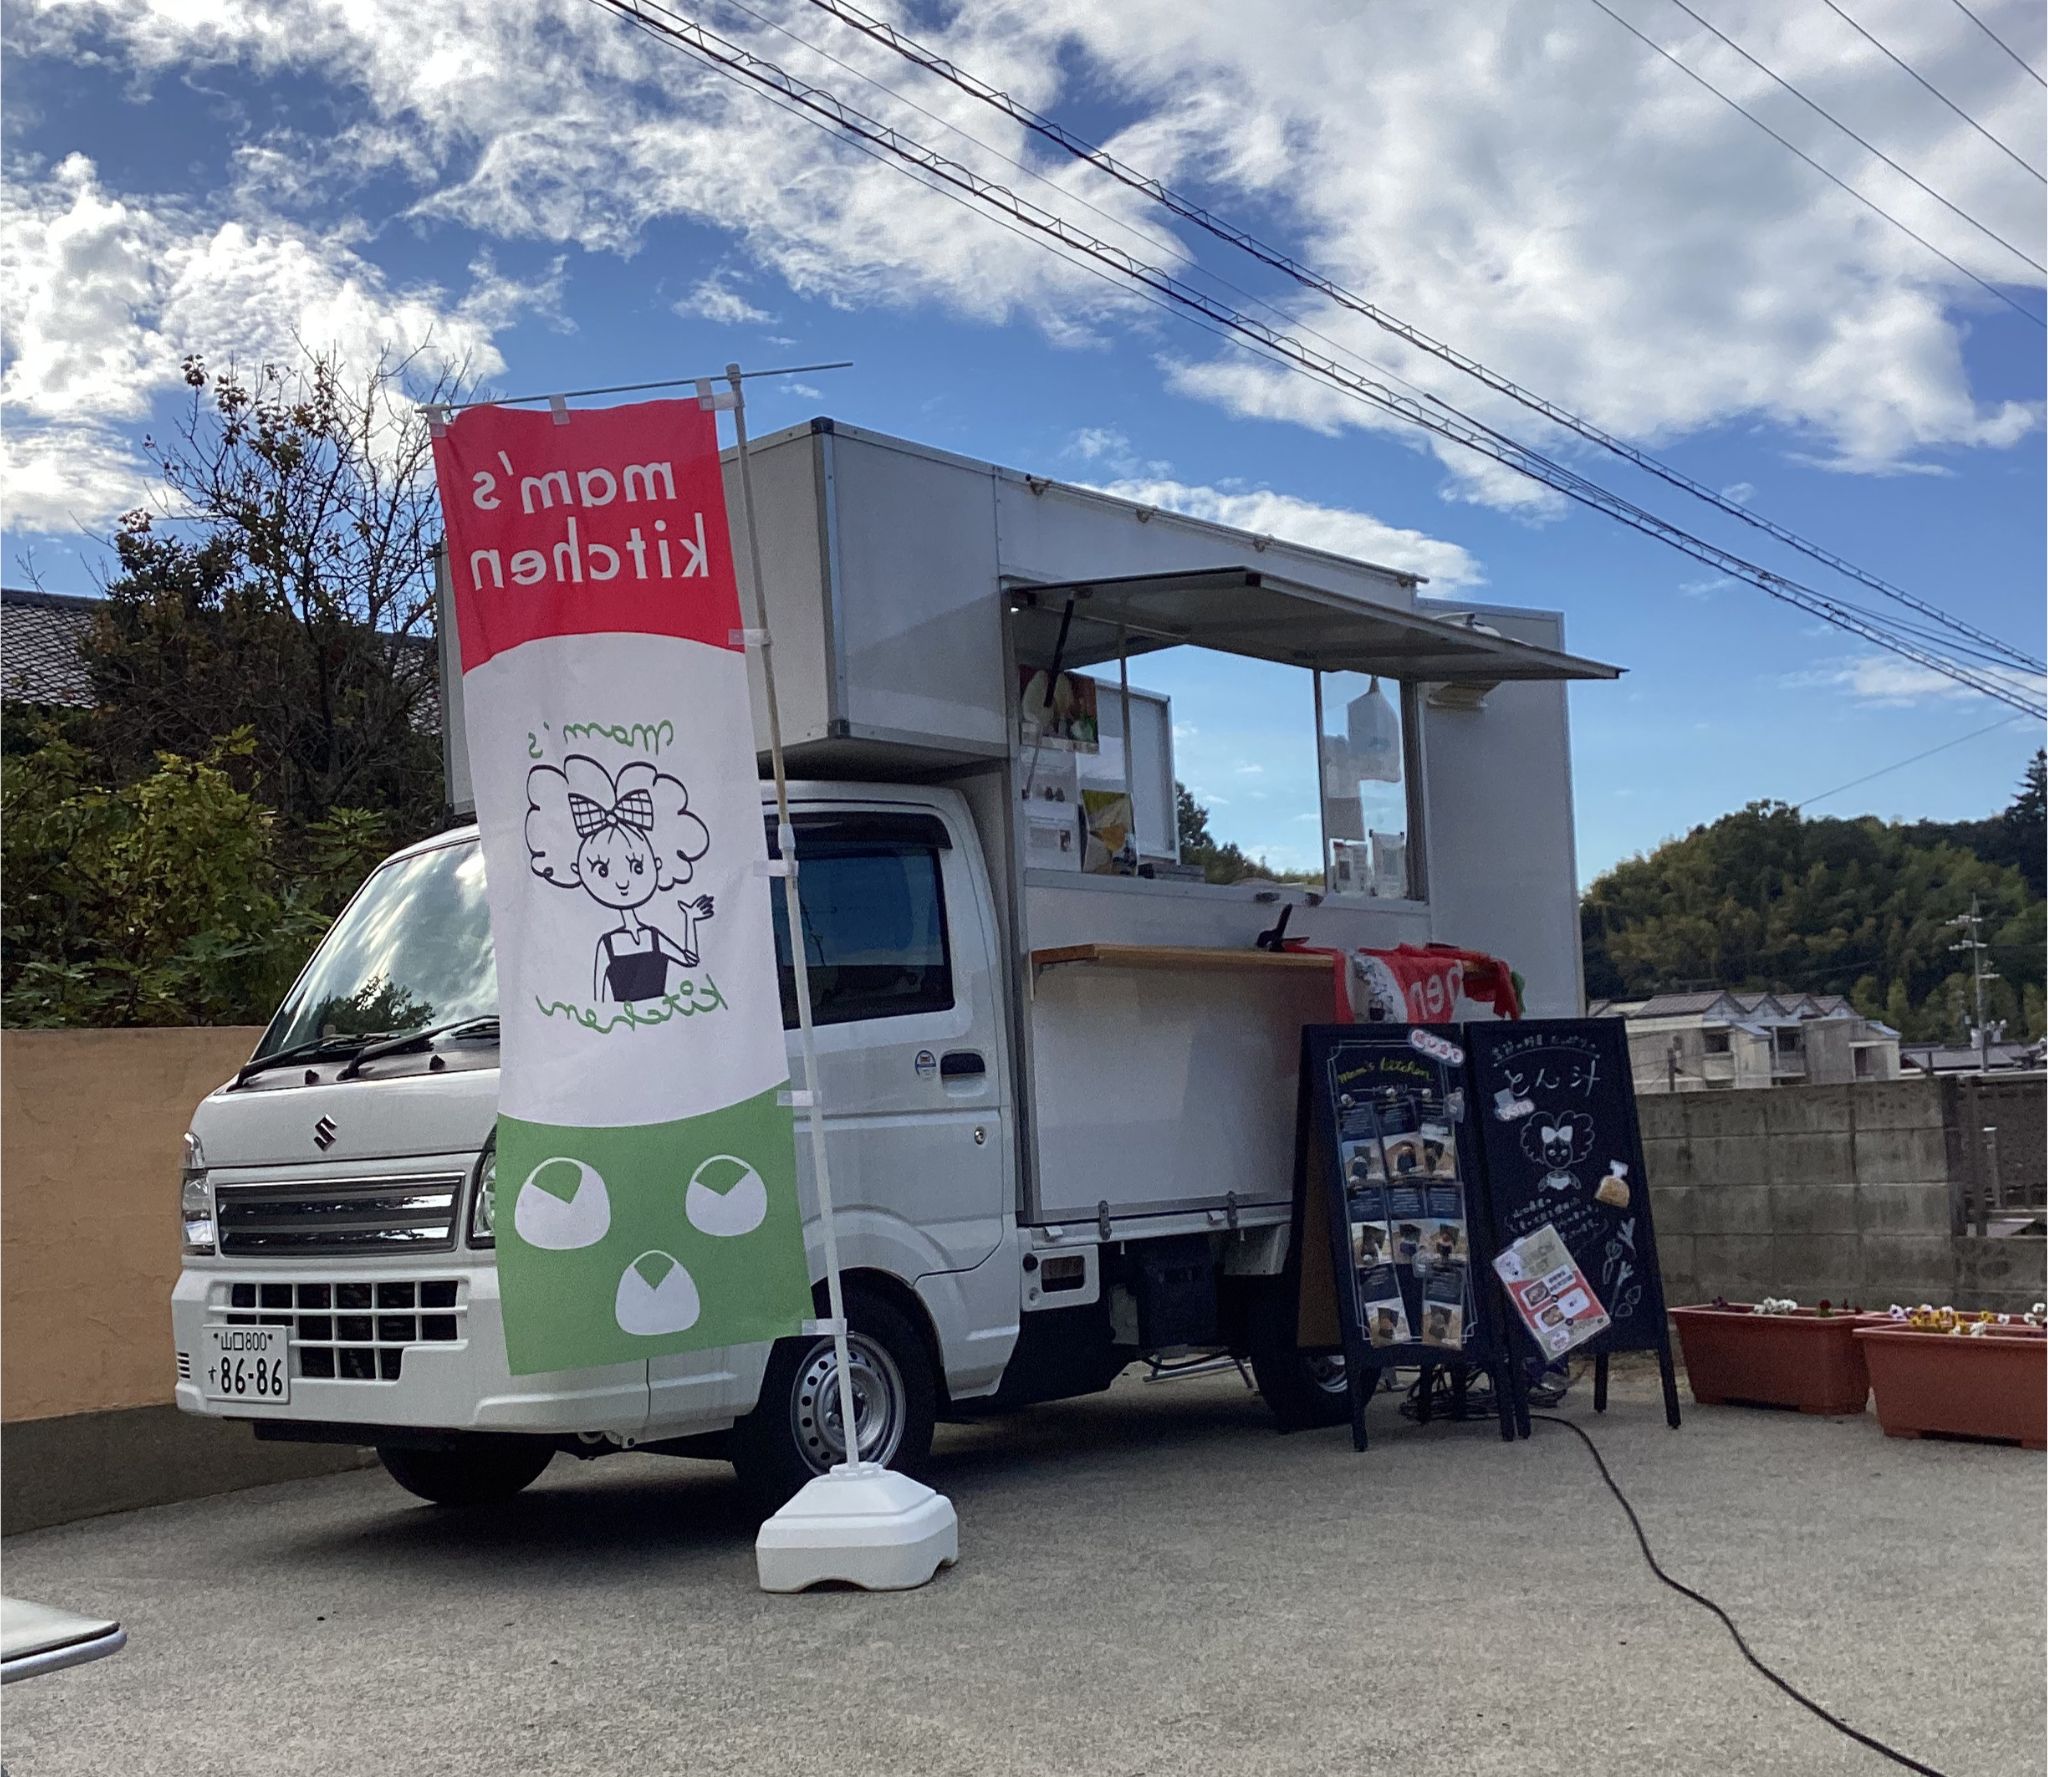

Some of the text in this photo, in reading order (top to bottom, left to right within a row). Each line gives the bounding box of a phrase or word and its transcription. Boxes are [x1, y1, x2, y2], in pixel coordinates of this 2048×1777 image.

[1504, 1059, 1601, 1097] とん汁
[220, 1356, 283, 1396] 86-86
